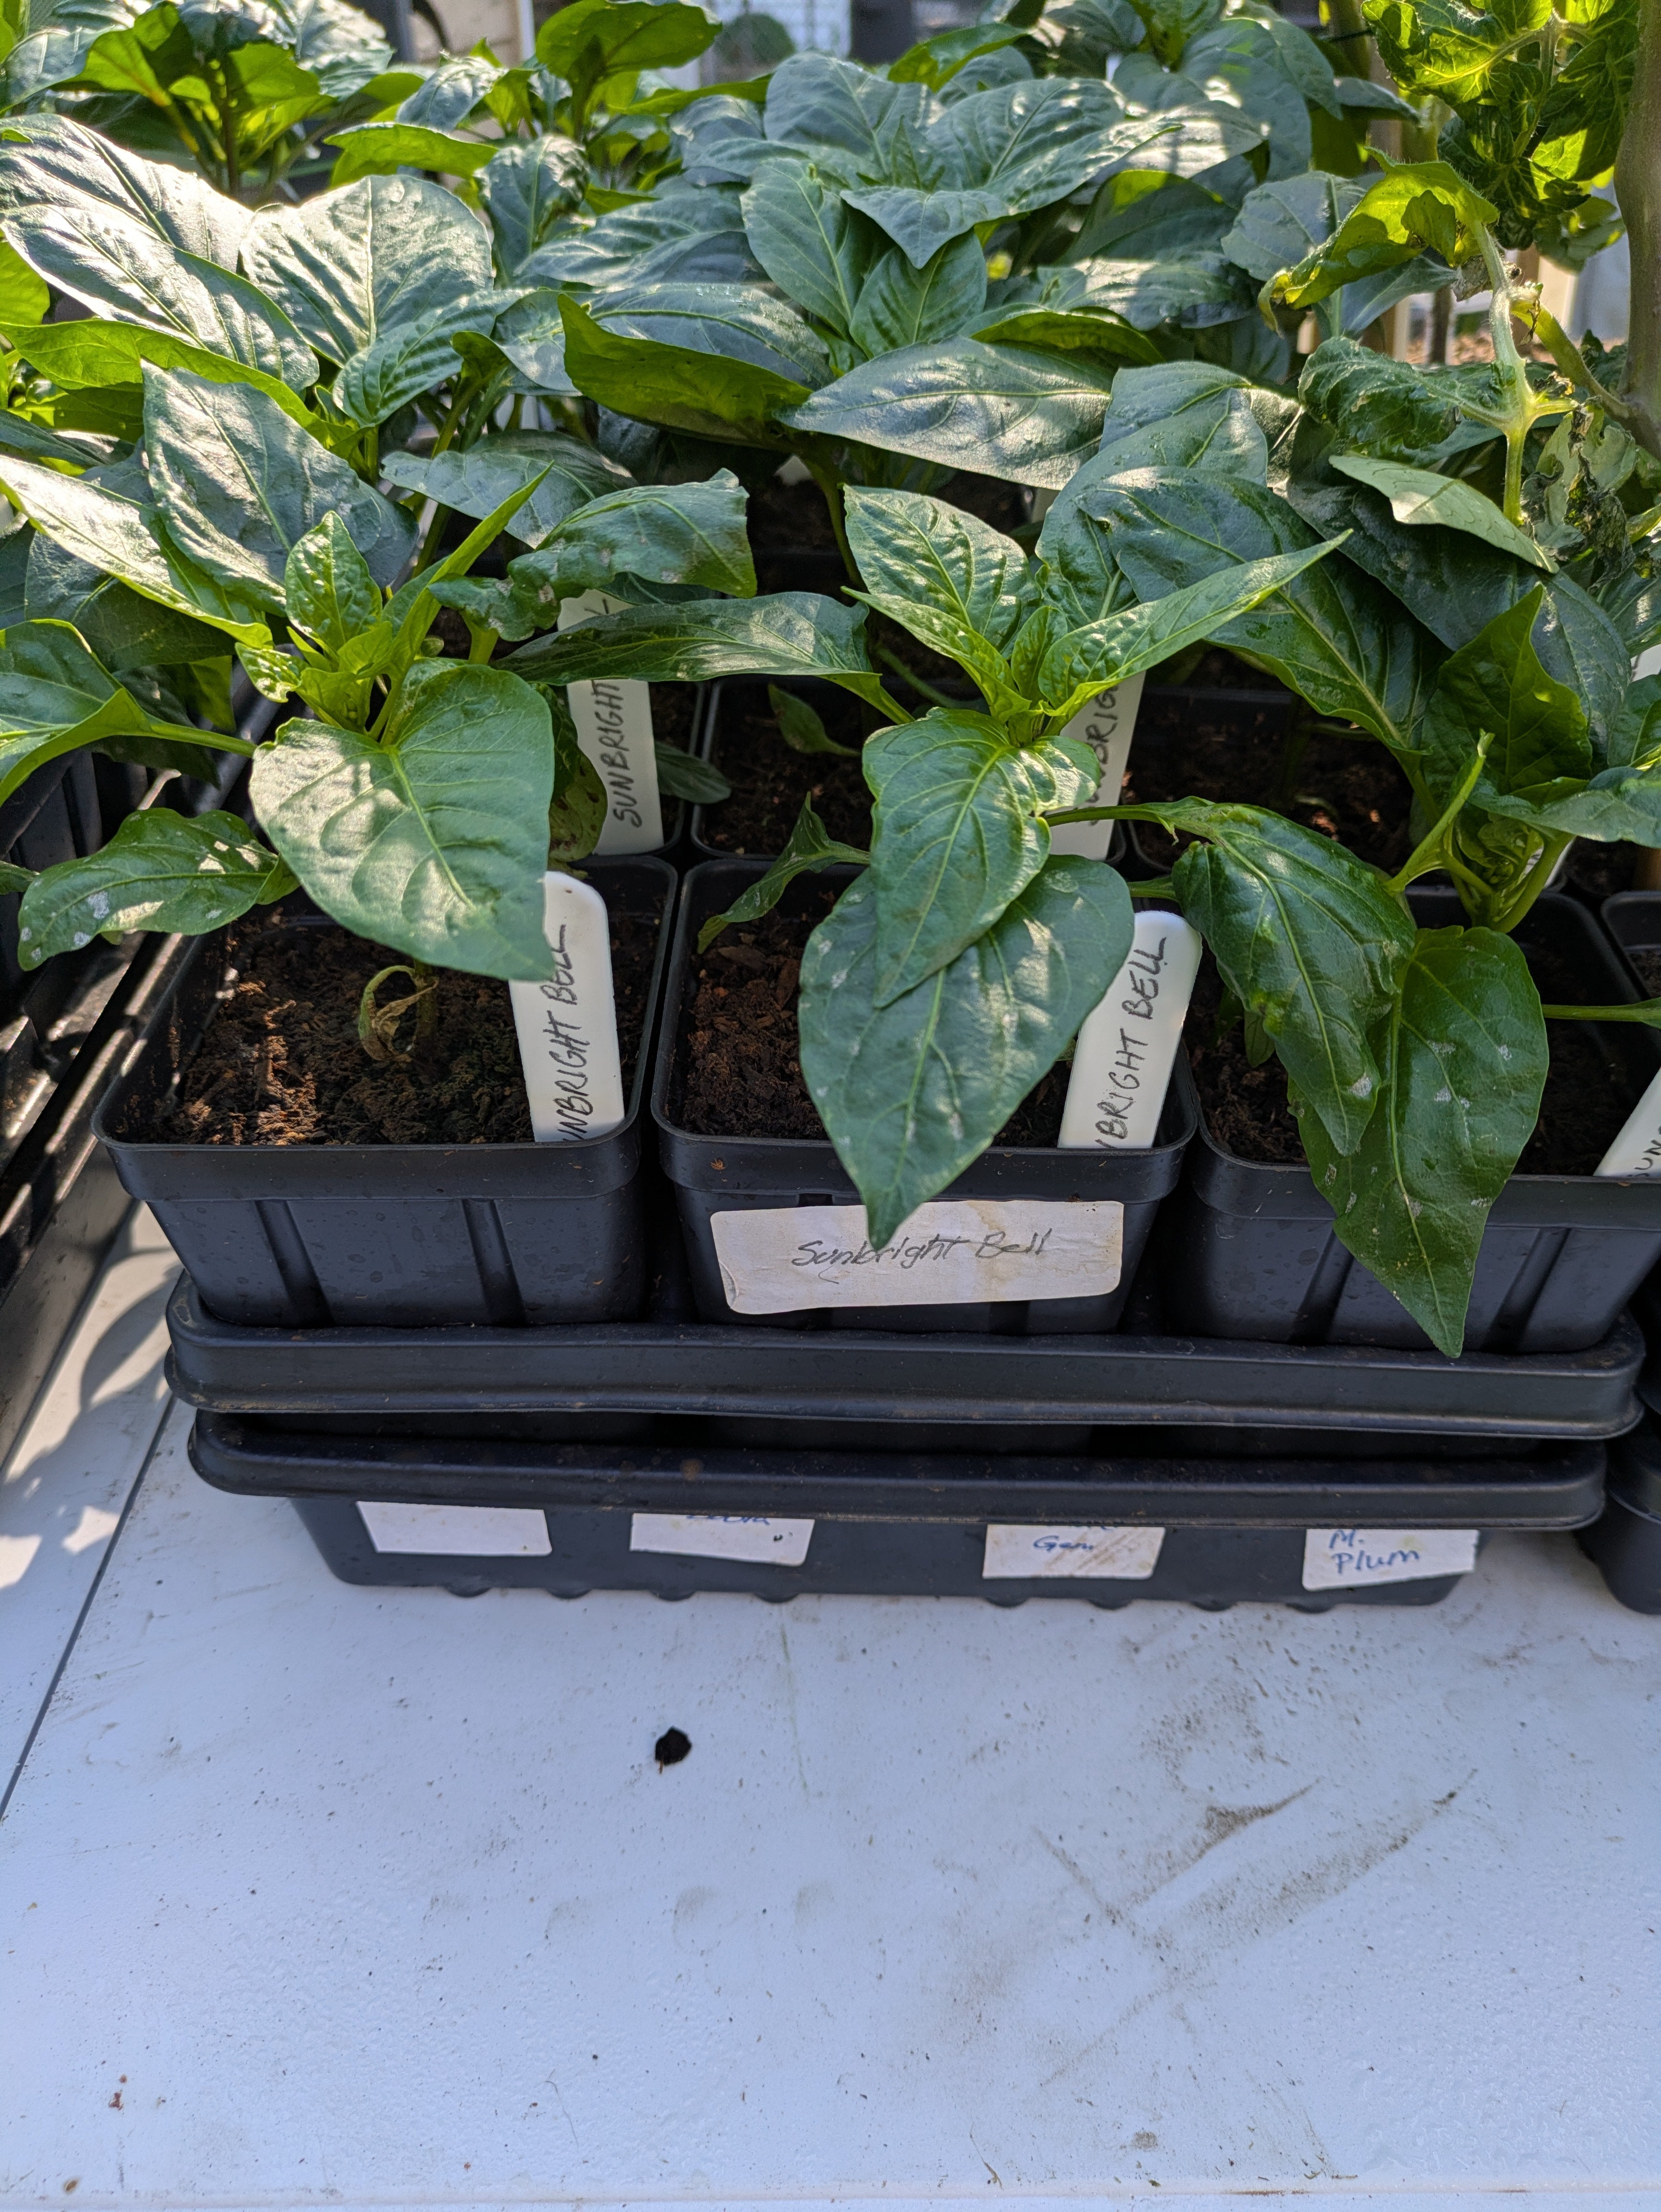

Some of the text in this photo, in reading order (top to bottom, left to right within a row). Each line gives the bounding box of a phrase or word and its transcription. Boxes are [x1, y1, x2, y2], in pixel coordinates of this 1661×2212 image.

[590, 679, 642, 828] SUNBRIGHT
[1122, 937, 1167, 1020] BELL
[975, 1228, 1052, 1259] Bell
[1331, 1550, 1419, 1574] Plum
